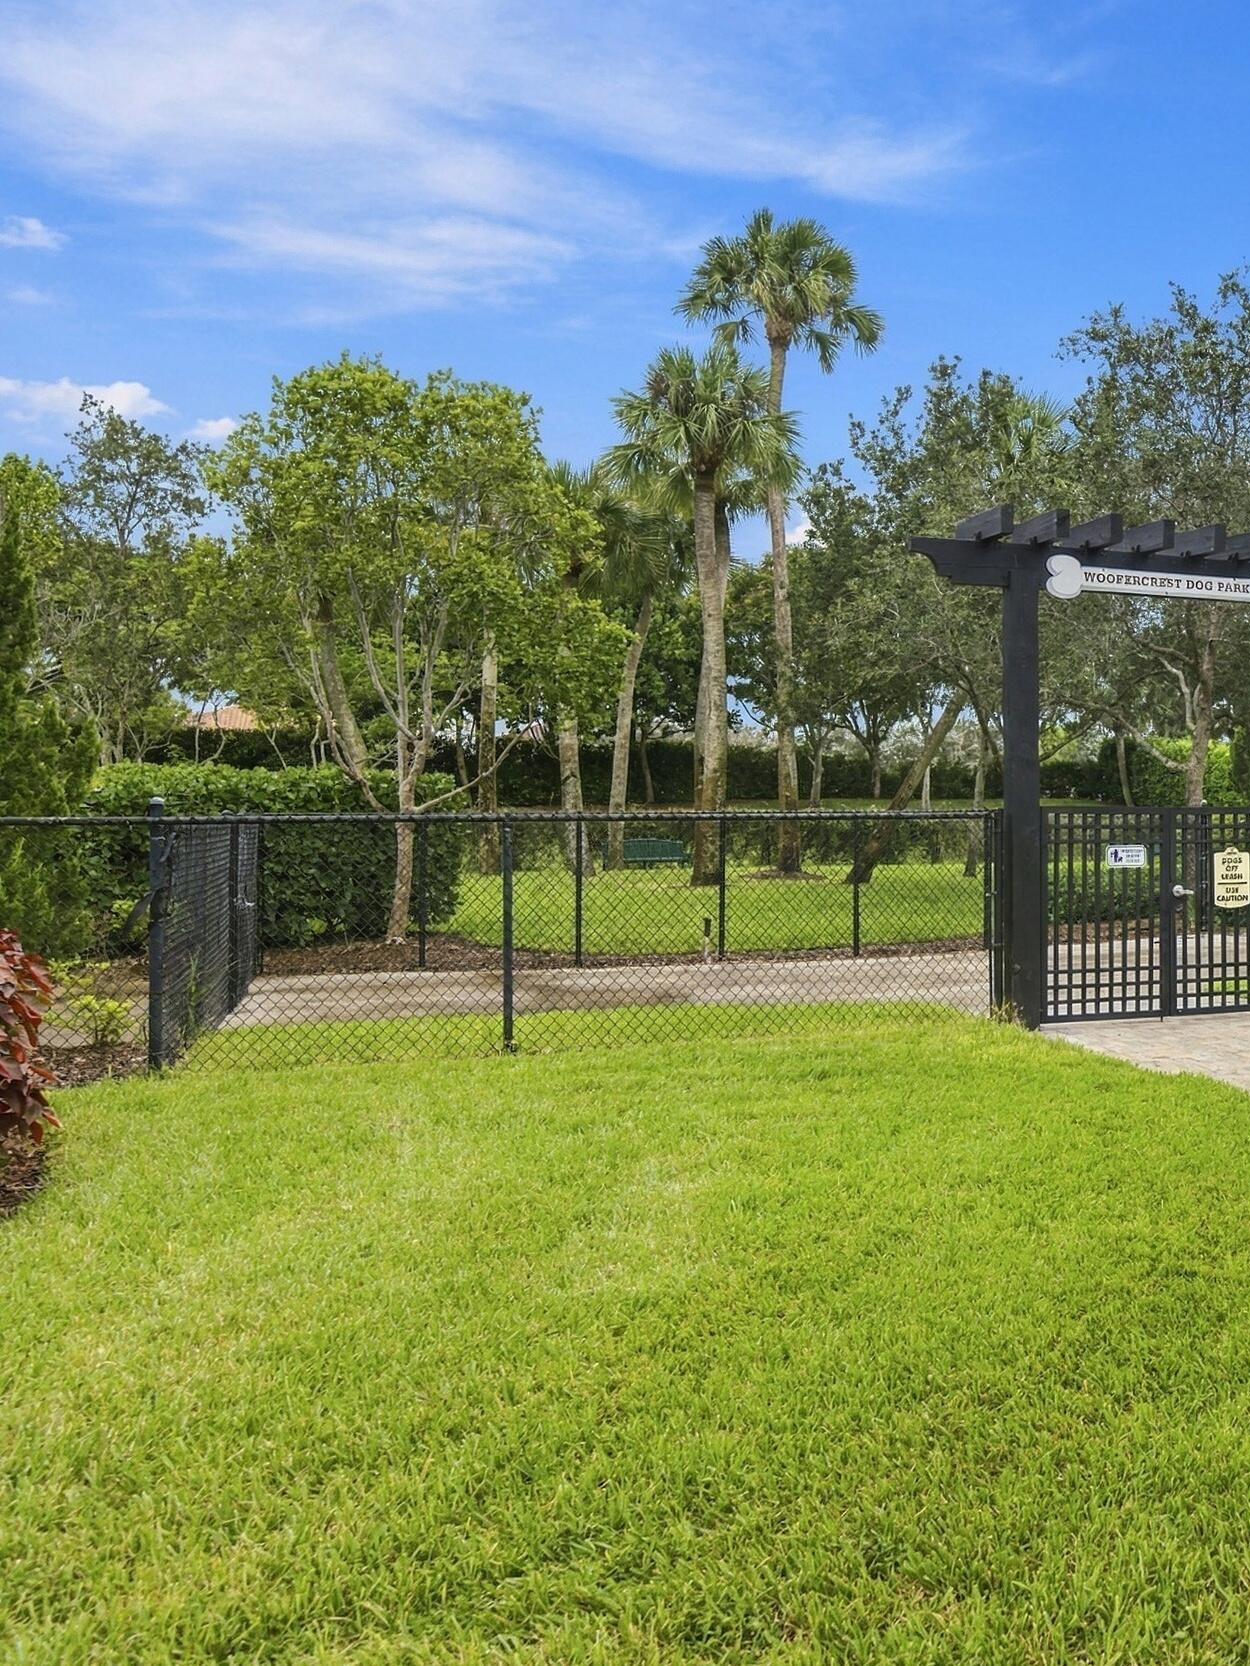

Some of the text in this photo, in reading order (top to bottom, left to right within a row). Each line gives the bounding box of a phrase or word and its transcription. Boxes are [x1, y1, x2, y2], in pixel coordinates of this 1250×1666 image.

[1084, 572, 1250, 593] WOOFERCREST DOG PARK
